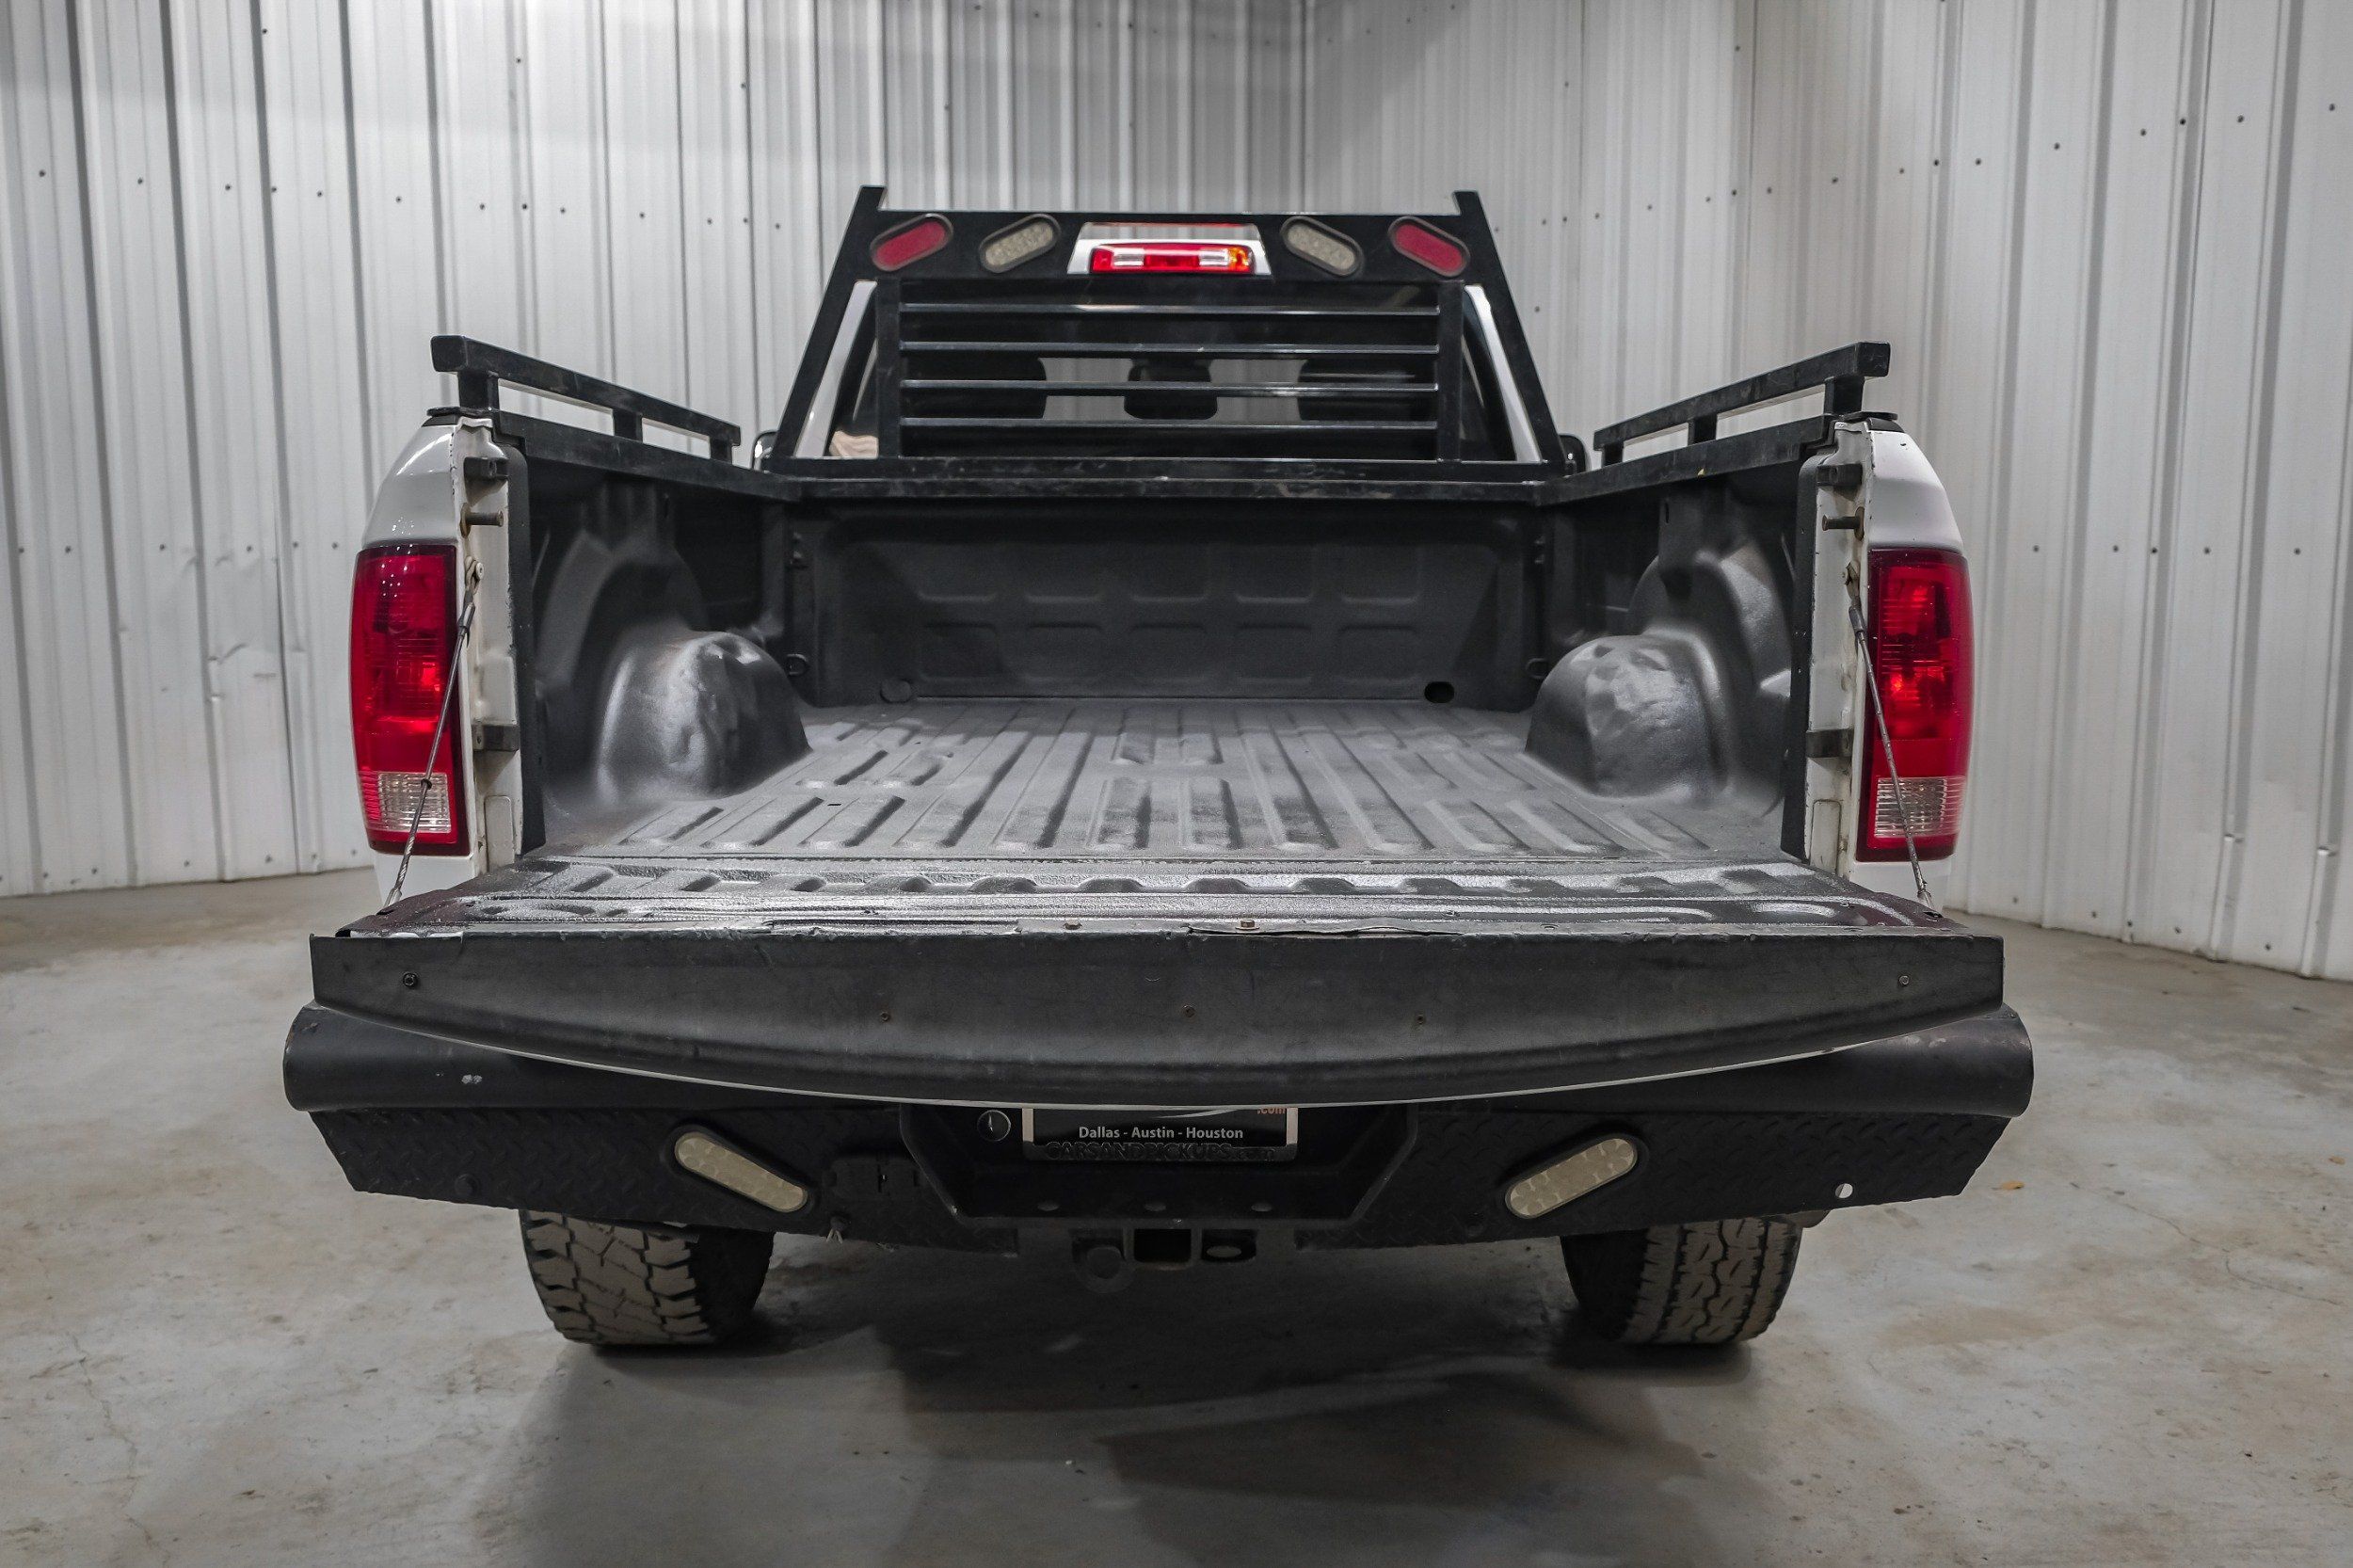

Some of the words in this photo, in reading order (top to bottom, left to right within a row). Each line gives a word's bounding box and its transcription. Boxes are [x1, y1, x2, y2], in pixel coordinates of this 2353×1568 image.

[1079, 1126, 1120, 1139] Dallas
[1131, 1126, 1175, 1139] Austin
[1186, 1126, 1243, 1139] Houston
